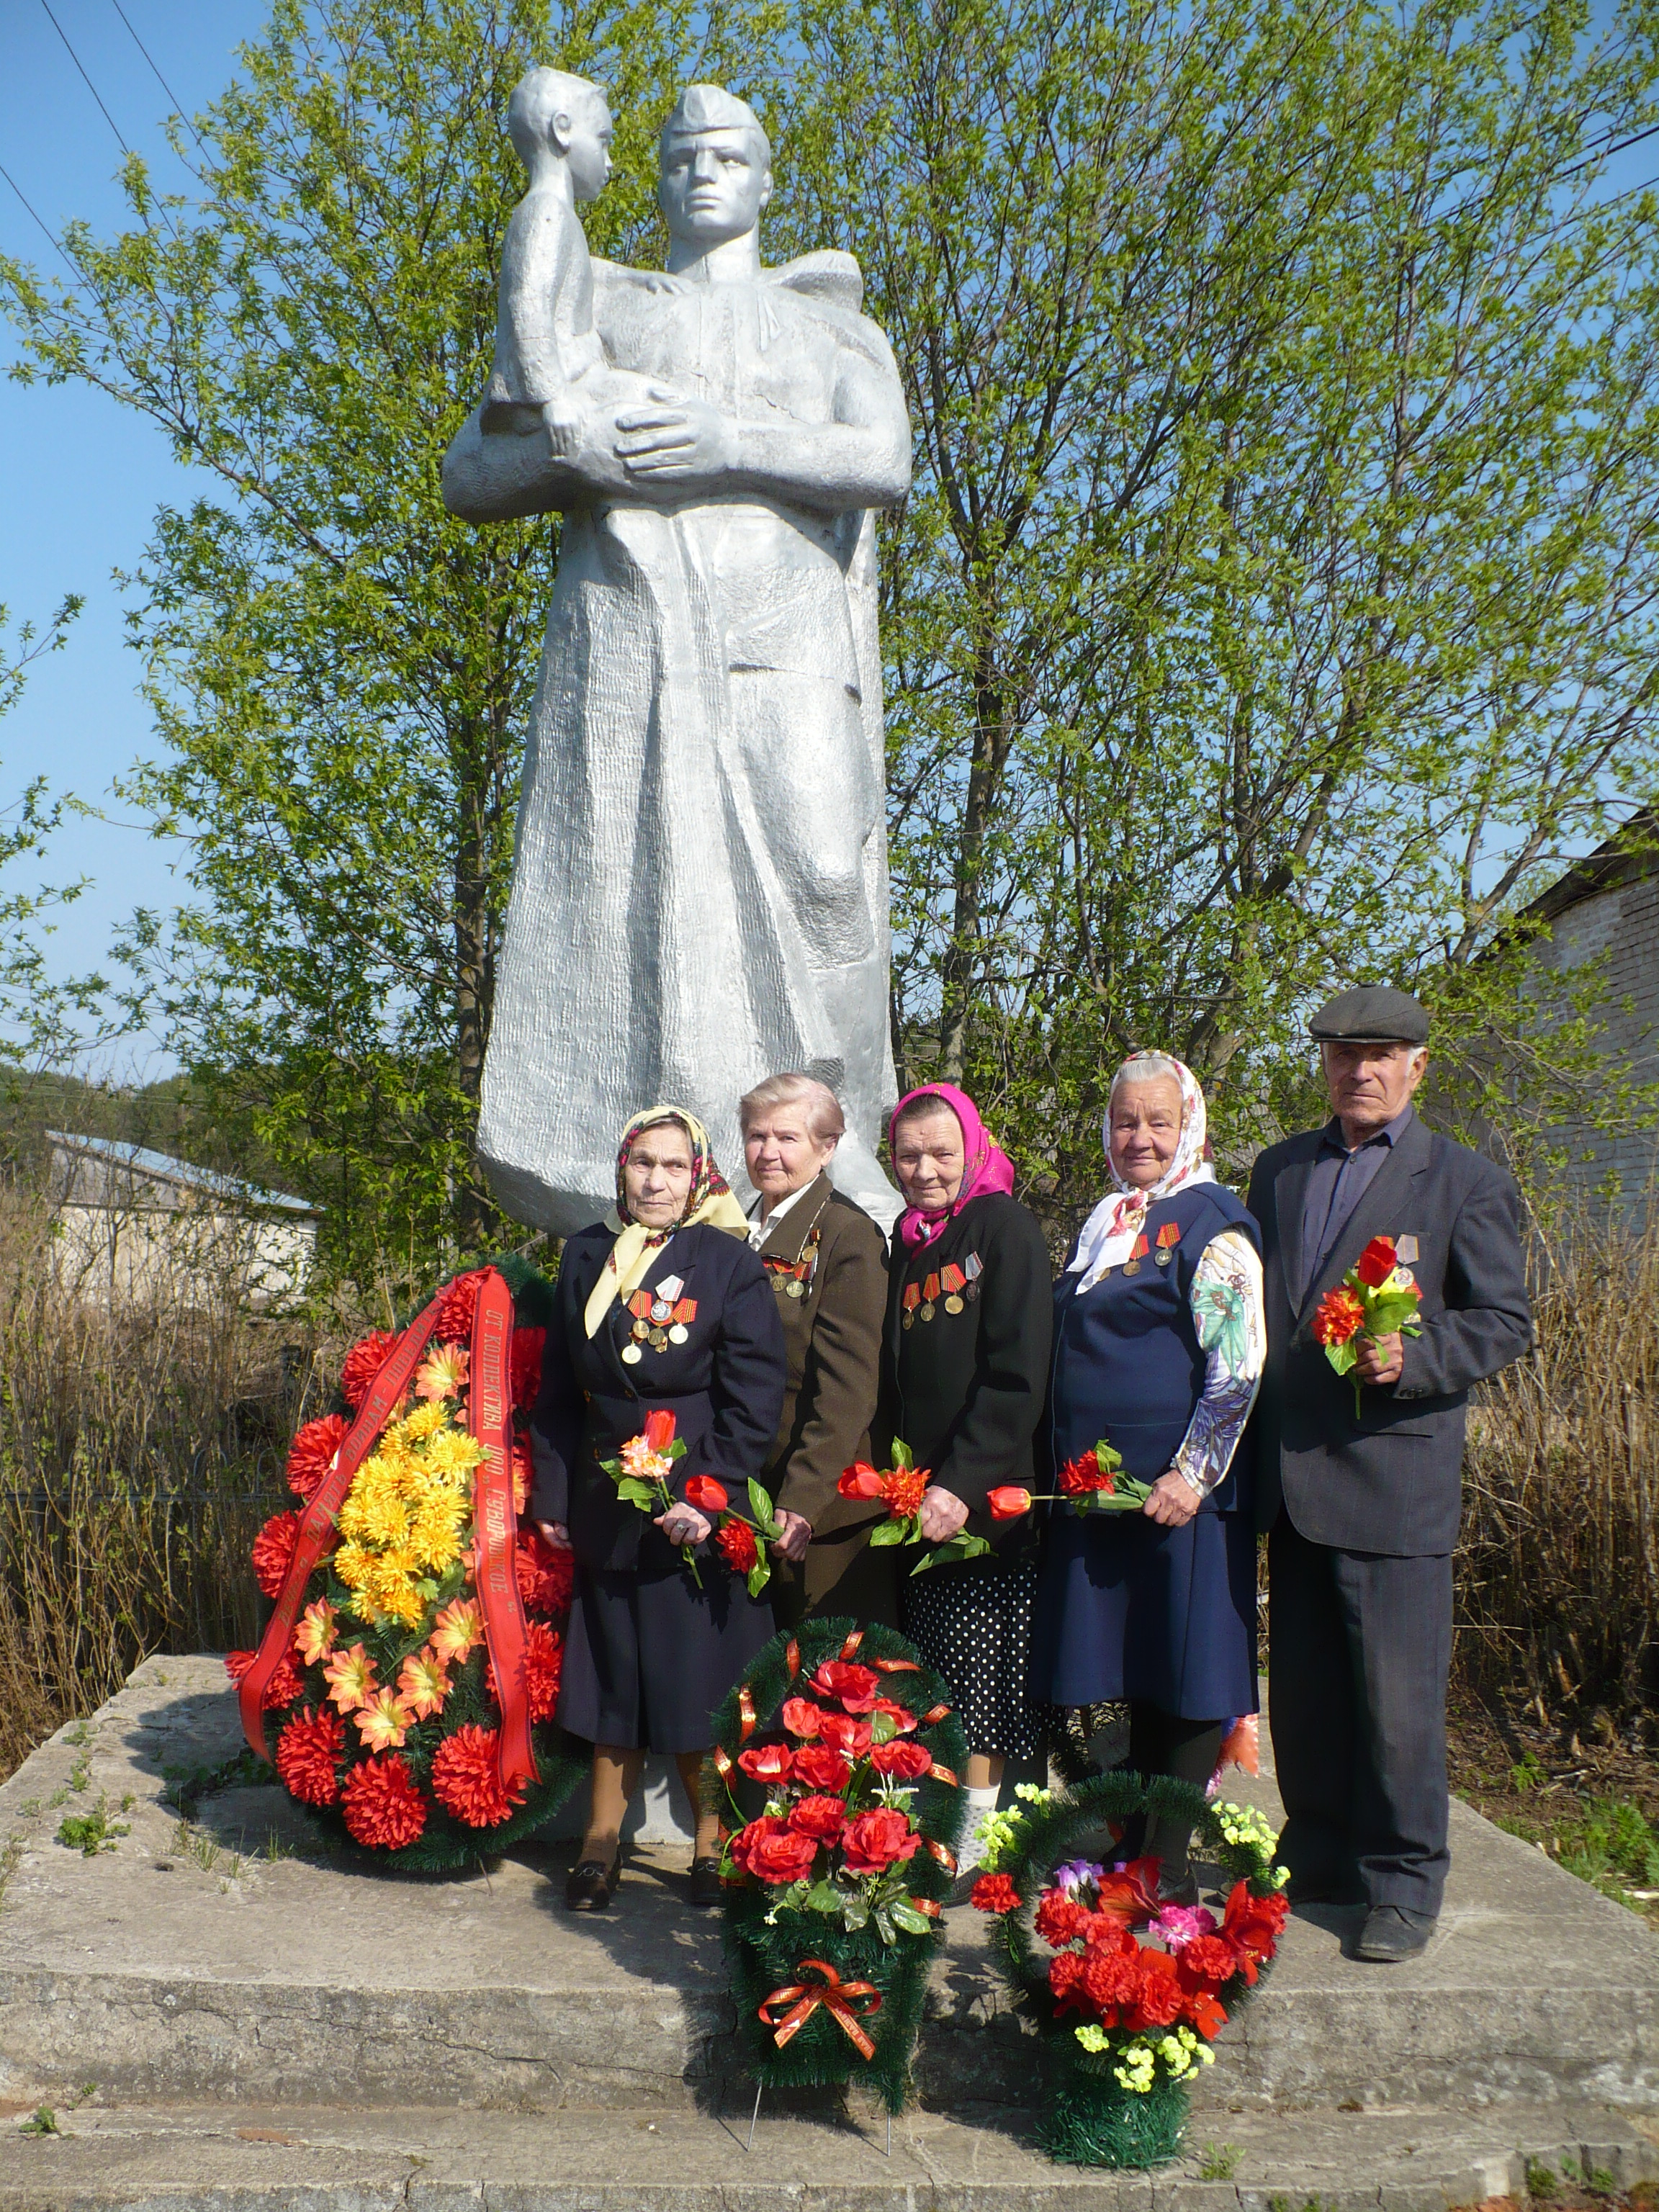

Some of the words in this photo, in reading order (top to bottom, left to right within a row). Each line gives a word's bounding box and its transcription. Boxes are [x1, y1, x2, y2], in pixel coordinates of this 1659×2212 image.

[485, 1309, 503, 1330] ОТ
[482, 1333, 502, 1431] КОЛЛЕКТИВА
[306, 1474, 347, 1546] ПАМЯТЬ
[345, 1395, 388, 1462] ВОИНАМ
[483, 1443, 504, 1475] ООО
